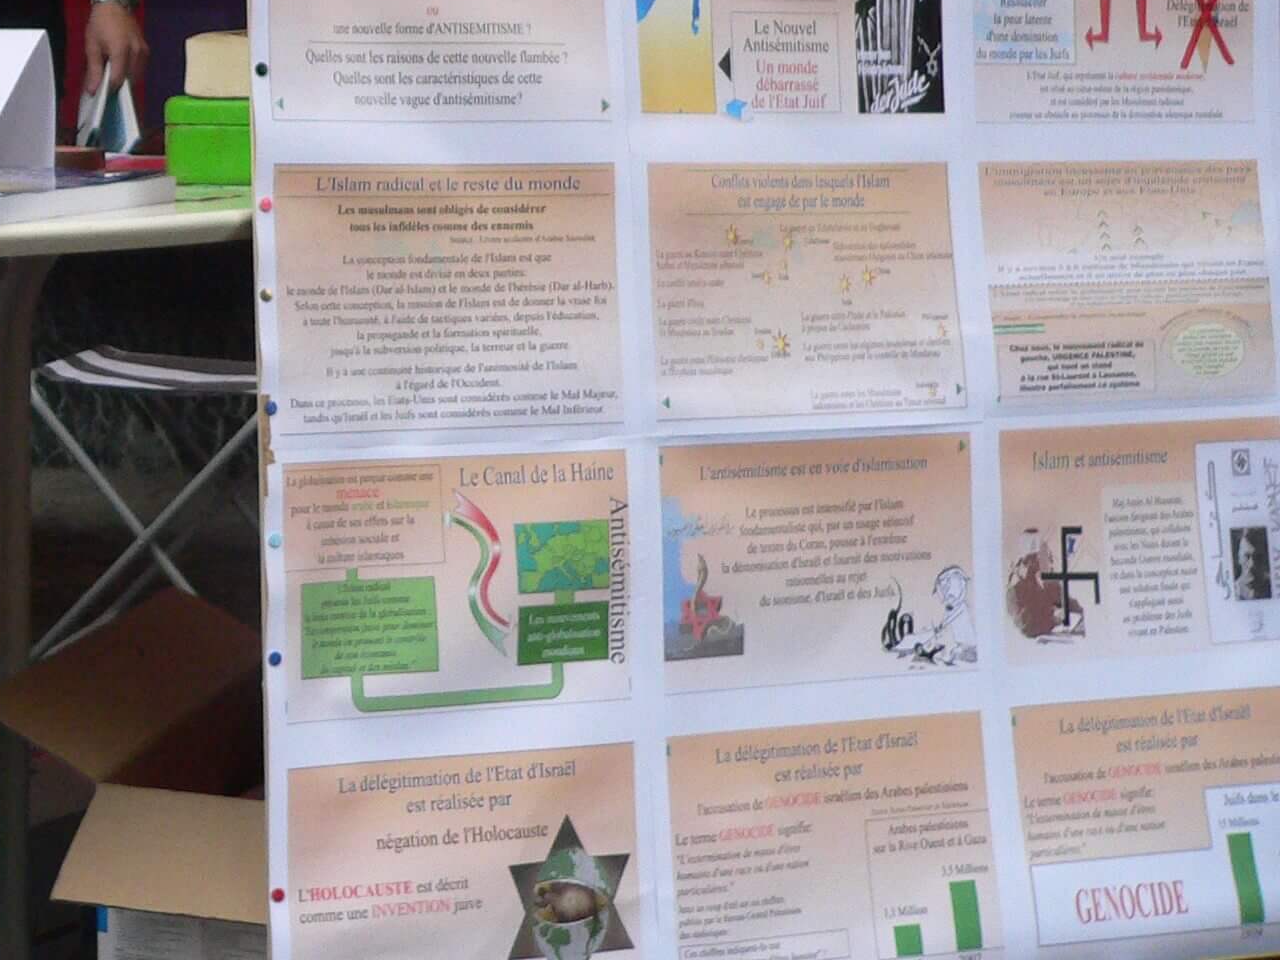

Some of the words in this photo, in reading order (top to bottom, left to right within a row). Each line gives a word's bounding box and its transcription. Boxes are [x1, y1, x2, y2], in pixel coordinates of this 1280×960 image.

[427, 8, 439, 16] ou
[333, 26, 350, 34] une
[352, 24, 392, 35] nouvelle
[395, 24, 424, 35] forme
[754, 20, 770, 34] Le
[773, 20, 817, 34] Nouvel
[743, 38, 830, 53] Antisémitisme
[305, 51, 342, 65] Quelles
[345, 52, 367, 64] sont
[369, 51, 384, 64] les
[387, 52, 424, 64] raisons
[427, 51, 440, 63] de
[443, 52, 468, 64] cette
[472, 52, 517, 64] nouvelle
[520, 52, 560, 65] flambée
[756, 62, 774, 74] Un
[778, 61, 818, 74] monde
[756, 77, 819, 91] débarrassé
[752, 95, 766, 108] de
[769, 94, 801, 109] l'Etat
[804, 94, 827, 109] Juif
[316, 176, 371, 192] L'Islam
[376, 177, 424, 192] radical
[429, 179, 441, 191] et
[446, 177, 459, 191] le
[463, 179, 500, 191] reste
[504, 177, 524, 191] du
[528, 177, 580, 191] monde
[700, 463, 788, 481] L'antisémitisme
[790, 465, 807, 475] est
[809, 465, 822, 475] en
[825, 461, 850, 475] voie
[852, 457, 928, 473] d'islamisation
[1033, 450, 1070, 472] Islam
[1075, 456, 1085, 468] et
[1088, 450, 1168, 469] antisémitisme
[459, 468, 479, 488] Le
[483, 465, 528, 486] Canal
[531, 463, 548, 483] de
[551, 463, 567, 483] la
[571, 462, 614, 482] Haine
[609, 496, 631, 664] Antisémitisme
[338, 777, 356, 793] La
[359, 769, 461, 792] délégitimation
[465, 768, 483, 784] de
[486, 765, 523, 783] l'Etat
[528, 760, 577, 779] d'Israël
[407, 799, 426, 813] est
[430, 794, 485, 811] réalisée
[488, 793, 512, 811] par
[376, 831, 438, 853] négation
[442, 829, 460, 844] de
[463, 823, 548, 844] l'Holocauste
[298, 880, 414, 902] L'HOLOCAUSTE
[417, 881, 434, 894] est
[437, 878, 469, 892] décrit
[299, 910, 344, 924] comme
[347, 908, 368, 920] une
[372, 900, 452, 919] INVENTION
[1075, 879, 1189, 925] GENOCIDE
